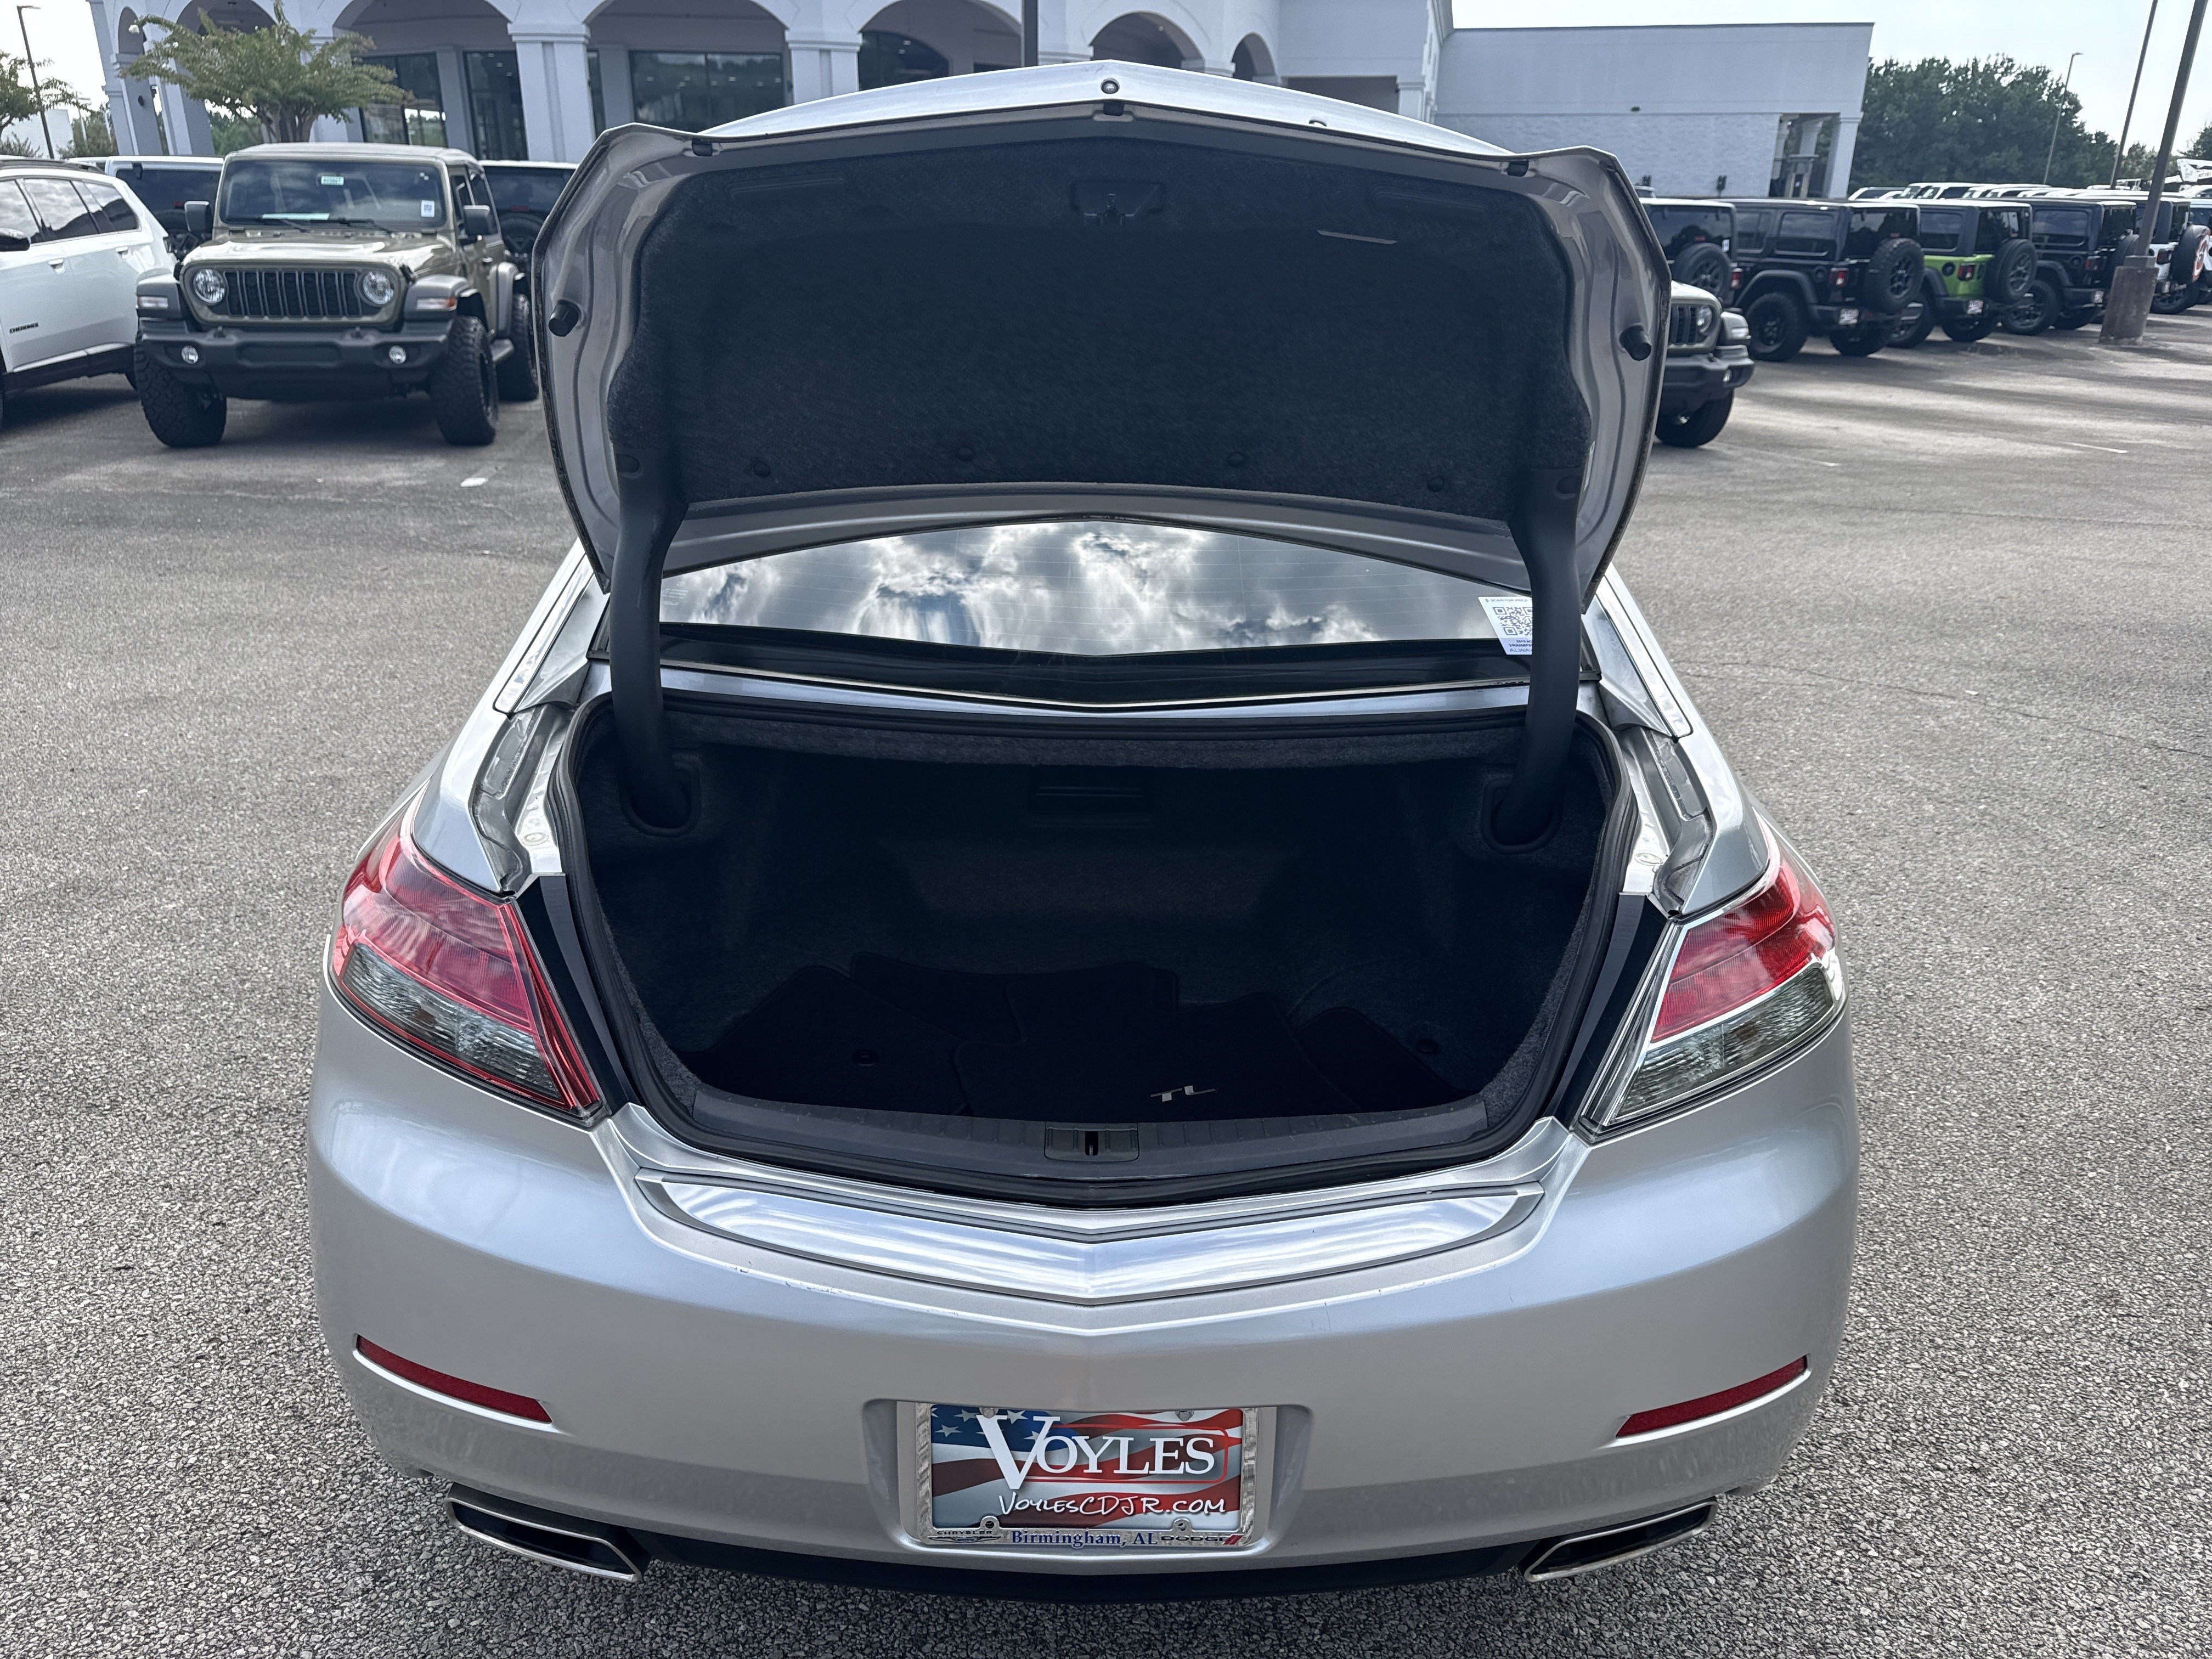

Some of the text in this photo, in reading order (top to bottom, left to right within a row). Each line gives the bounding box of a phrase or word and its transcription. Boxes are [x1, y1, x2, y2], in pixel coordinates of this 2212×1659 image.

[1150, 1085, 1216, 1102] TL
[976, 1414, 1215, 1490] VOYLES
[1011, 1528, 1158, 1548] Birmingham, AL
